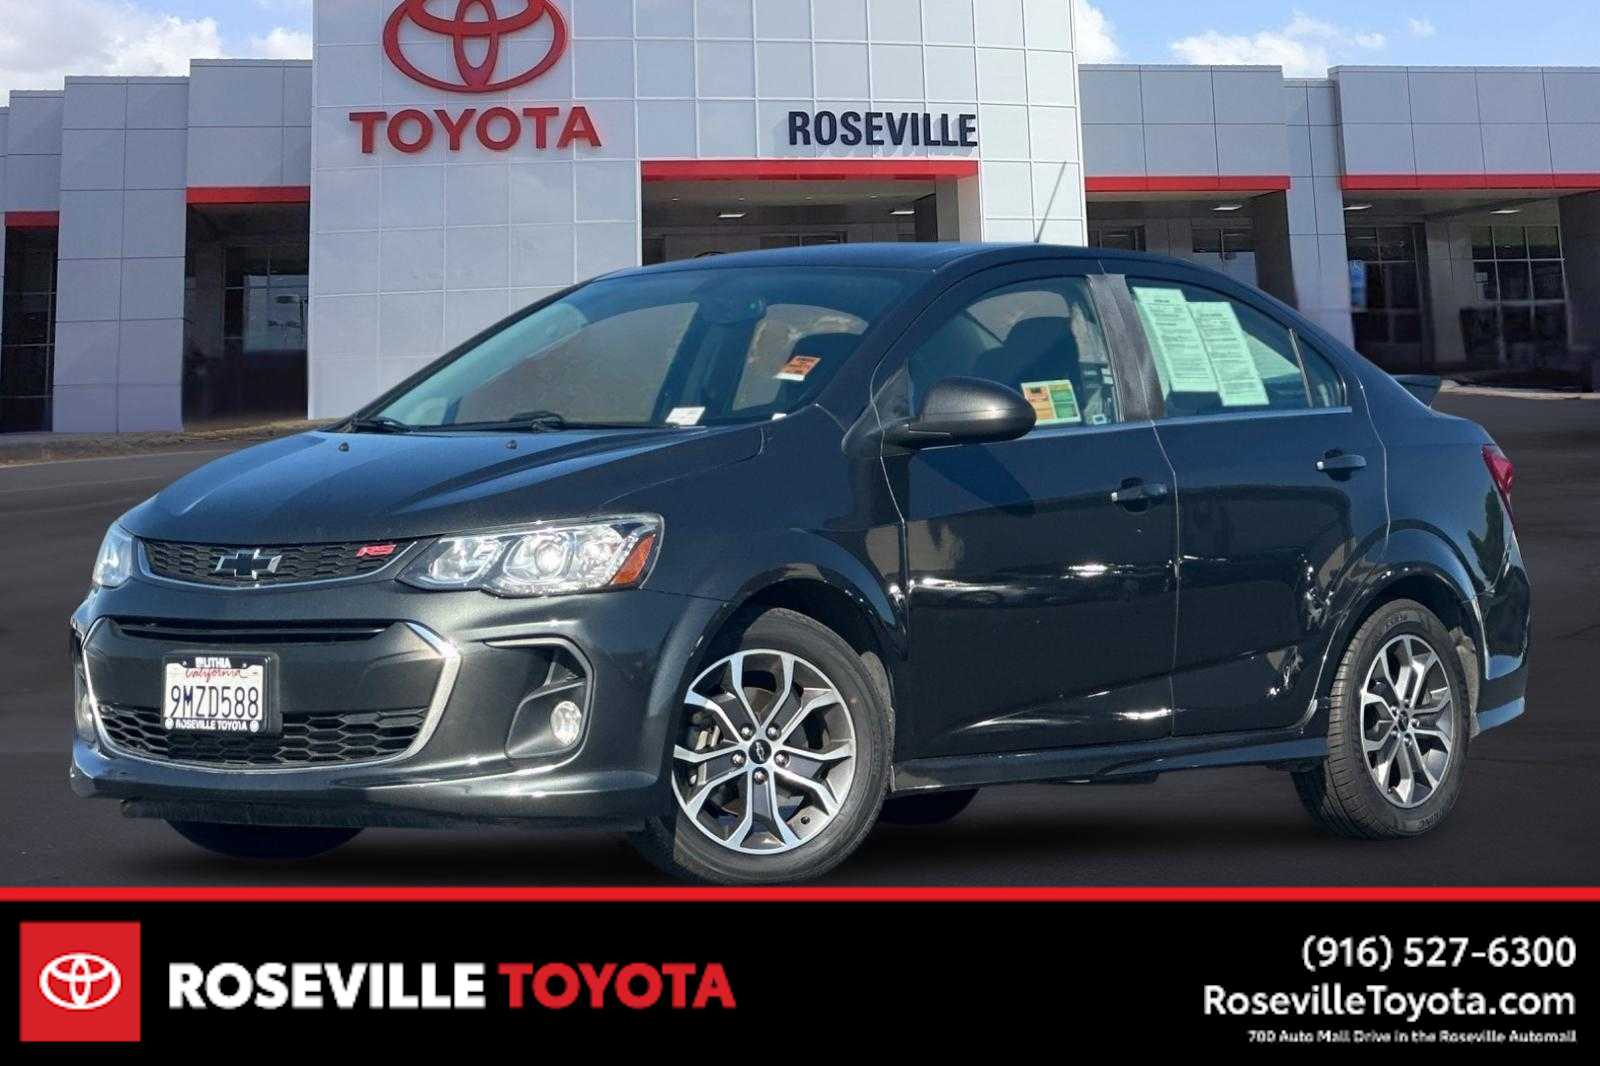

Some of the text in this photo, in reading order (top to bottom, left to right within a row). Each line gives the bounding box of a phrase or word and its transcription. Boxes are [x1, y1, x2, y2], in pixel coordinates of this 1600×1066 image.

[349, 105, 602, 154] TOYOTA
[787, 110, 979, 148] ROSEVILLE
[356, 544, 397, 557] RS
[170, 685, 259, 718] 9MZD588
[175, 719, 247, 731] ROSEVILLE TOYOTA
